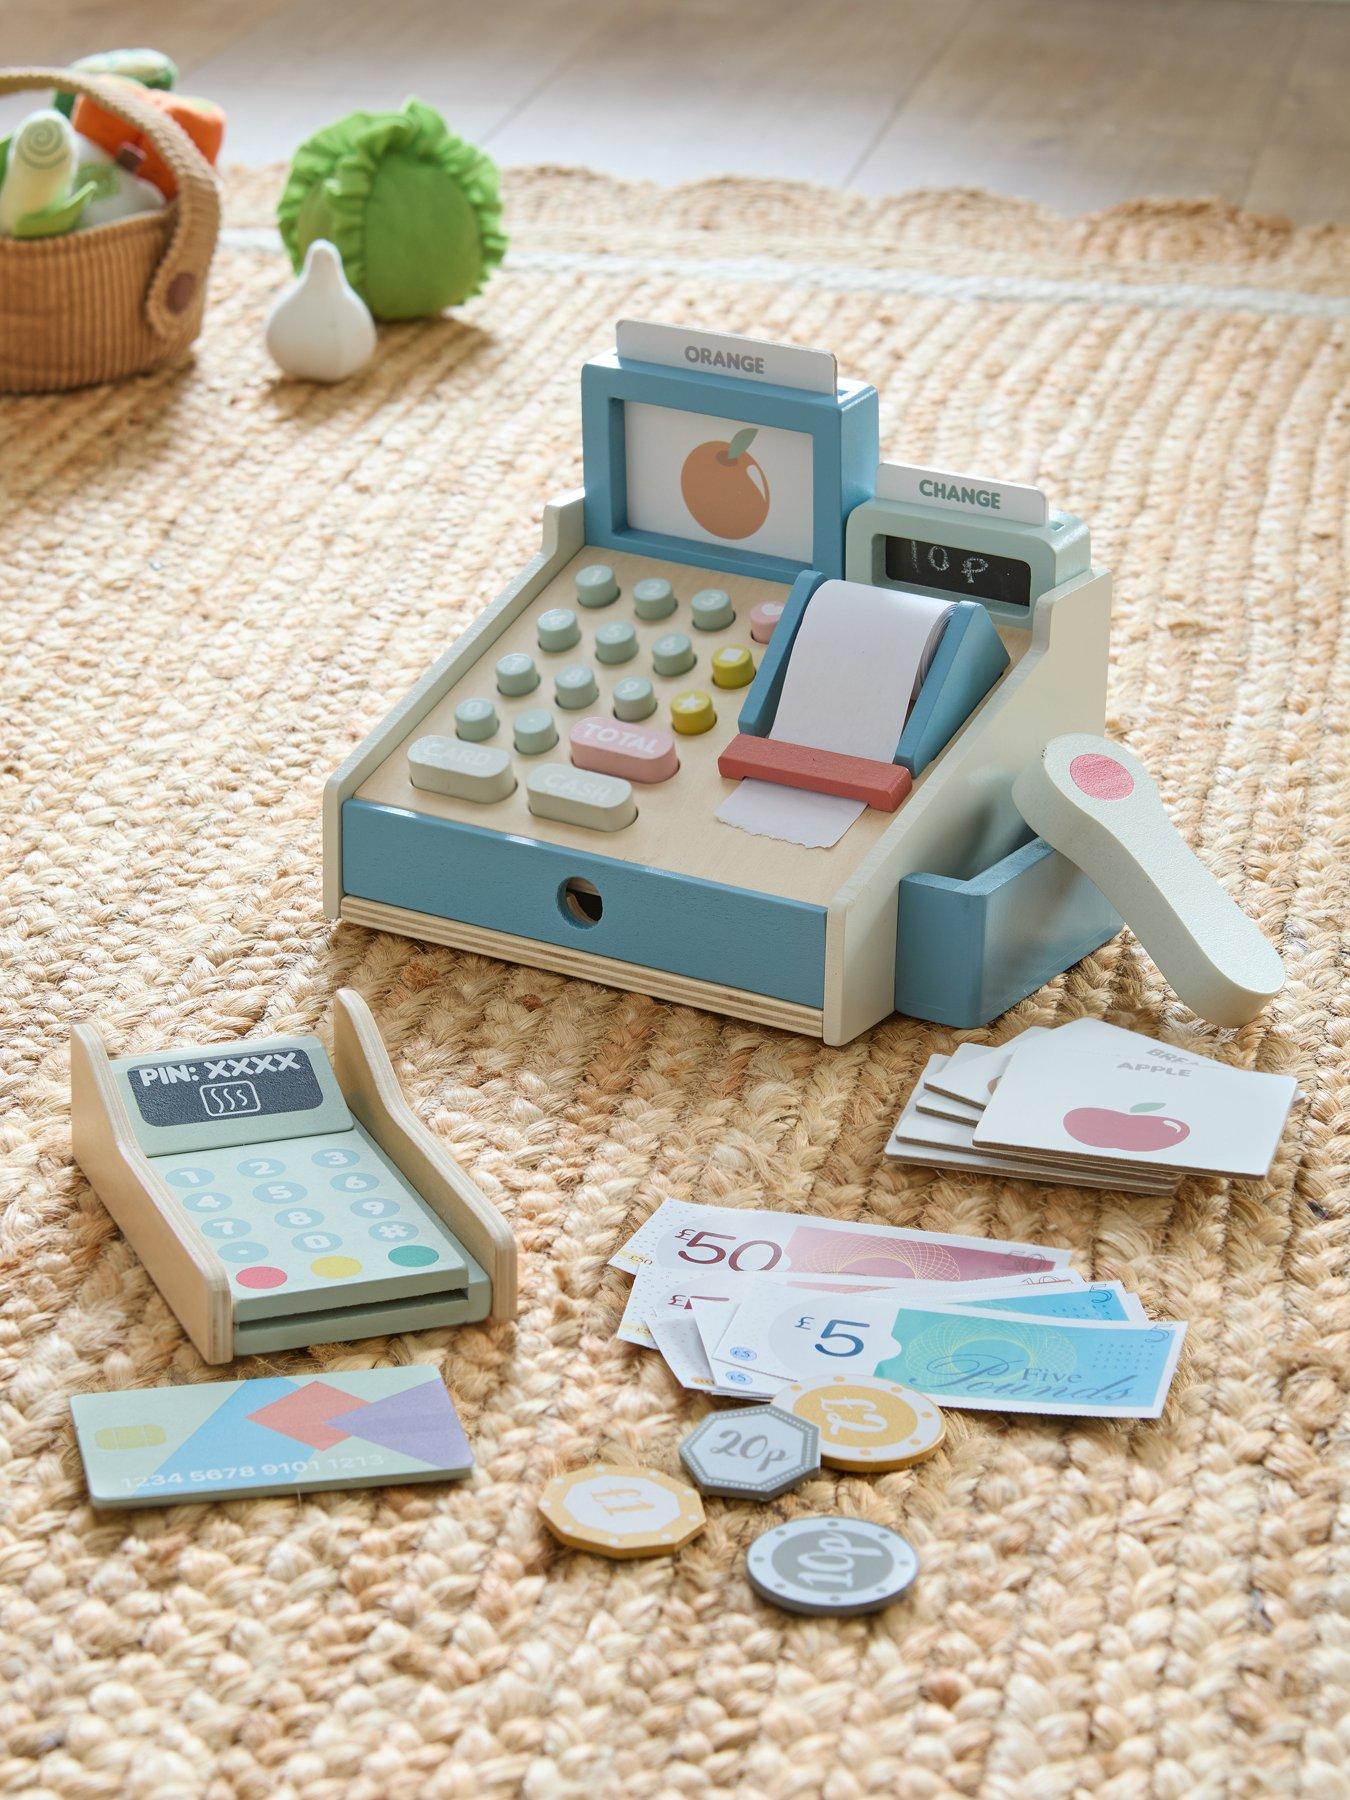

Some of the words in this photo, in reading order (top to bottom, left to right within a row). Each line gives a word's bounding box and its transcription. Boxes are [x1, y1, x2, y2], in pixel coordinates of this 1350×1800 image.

[684, 345, 764, 374] ORANGE
[919, 479, 1001, 509] CHANGE
[645, 583, 662, 595] 2
[701, 593, 722, 605] 3
[620, 680, 639, 694] 9
[424, 742, 491, 765] CARD
[584, 723, 658, 753] TOTAL
[544, 773, 612, 799] CASH
[138, 1065, 199, 1086] PIN:
[204, 1052, 301, 1079] XXXX
[1117, 1062, 1192, 1077] APPLE
[180, 1171, 200, 1183] 1
[248, 1161, 275, 1175] 2
[324, 1151, 349, 1165] 3
[196, 1195, 221, 1208] 4
[267, 1185, 292, 1199] 5
[345, 1175, 368, 1189] 6
[212, 1221, 234, 1235] 7
[288, 1211, 312, 1225] 8
[362, 1201, 385, 1215] 9
[303, 1234, 331, 1249] 0
[675, 1228, 782, 1271] £50
[795, 1316, 871, 1357] £5
[908, 1353, 1140, 1400] Pounds
[1021, 1367, 1083, 1384] Five
[710, 1429, 794, 1472] 20p
[120, 1473, 184, 1489] 1234
[190, 1465, 255, 1482] 5678
[261, 1459, 320, 1475] 9101
[328, 1454, 385, 1470] 1213
[797, 1530, 883, 1588] 10p
